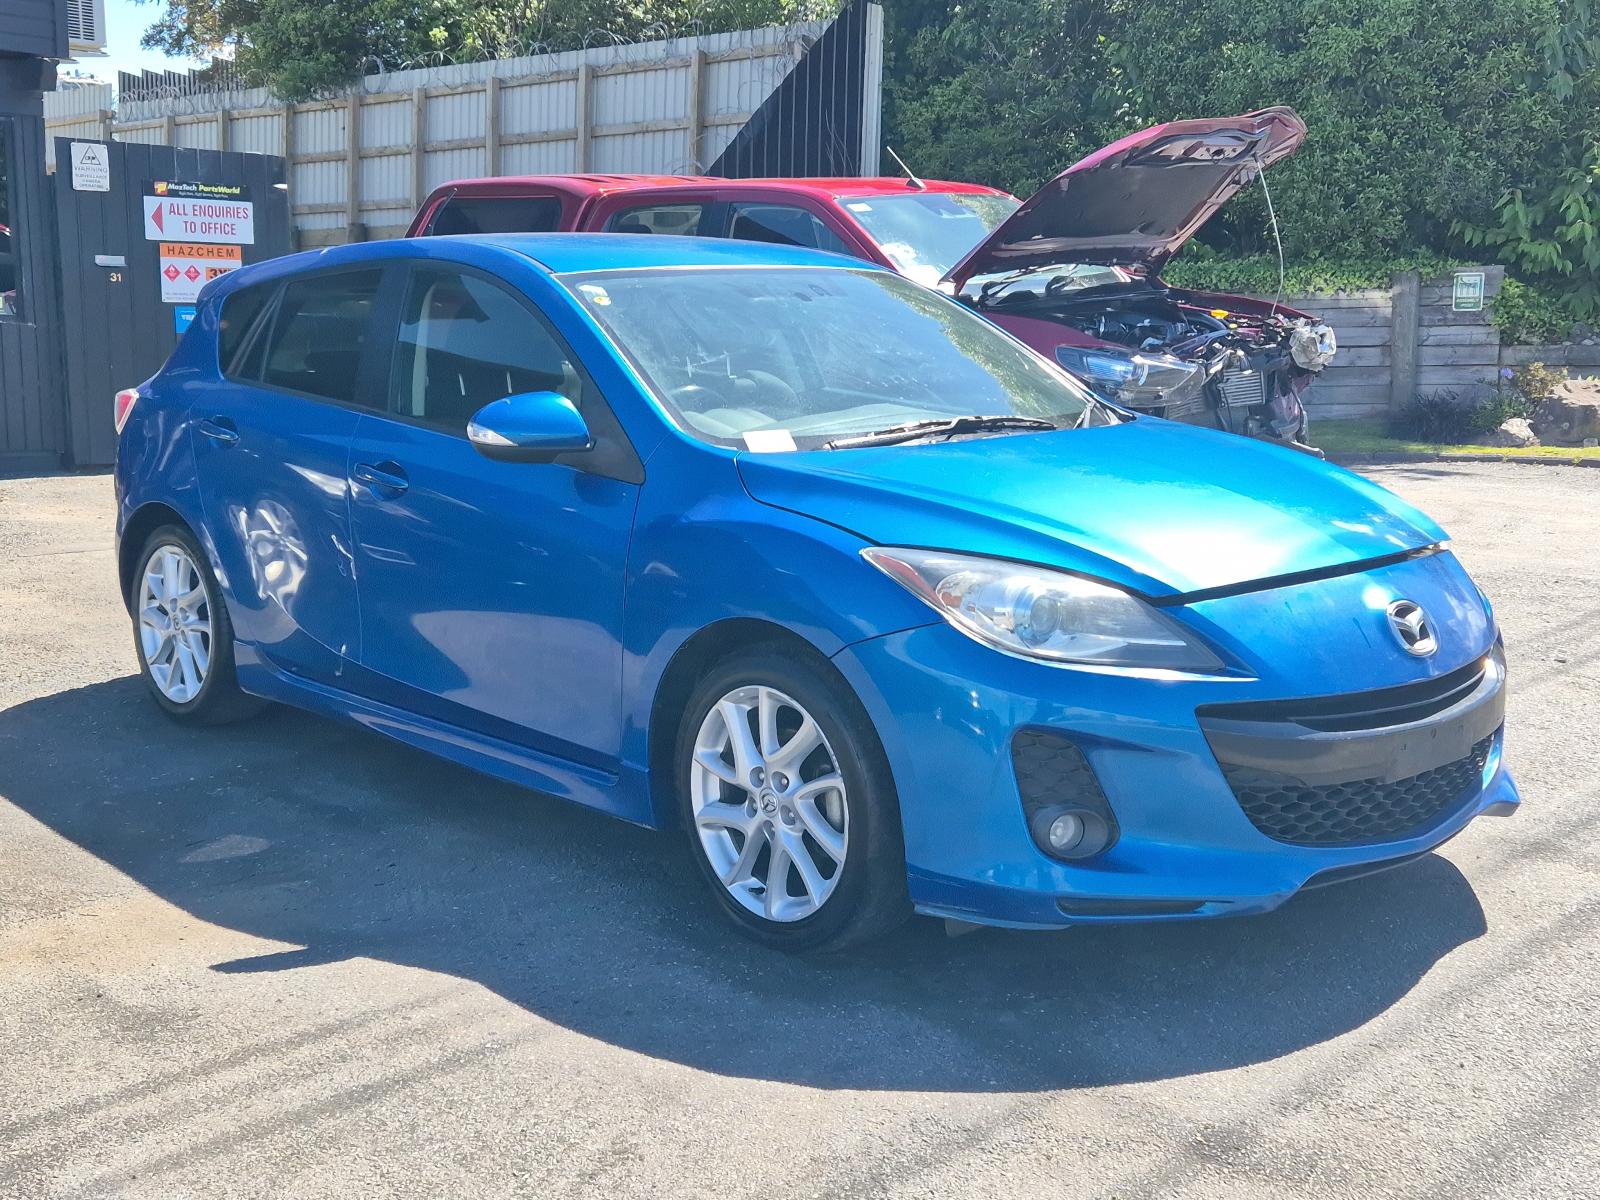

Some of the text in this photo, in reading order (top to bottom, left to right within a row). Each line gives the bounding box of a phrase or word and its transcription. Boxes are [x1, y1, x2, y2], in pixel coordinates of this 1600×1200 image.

[199, 184, 240, 194] PartsWorld
[169, 203, 249, 219] ALL ENQUIRIES
[184, 221, 236, 235] TO OFFICE
[167, 246, 235, 257] HAZCHEM
[110, 272, 122, 282] 31
